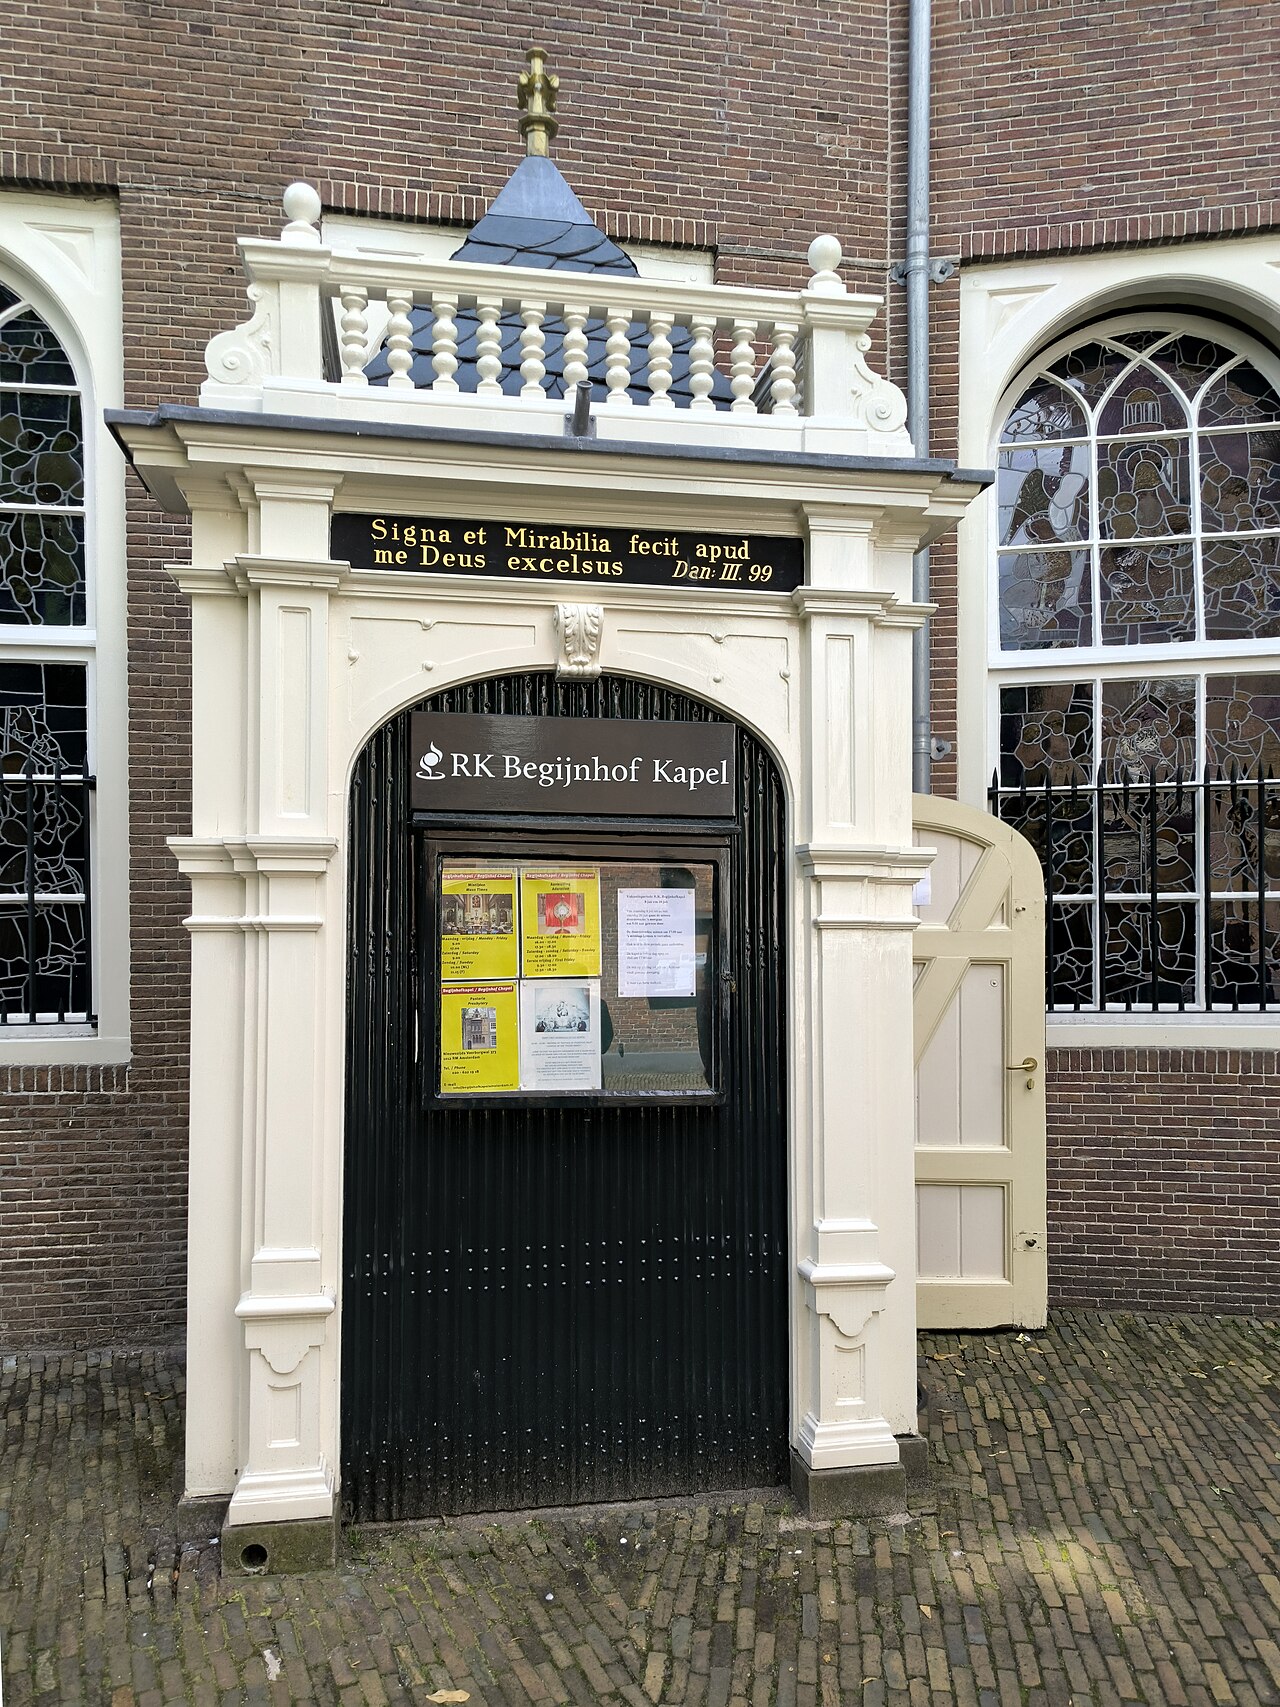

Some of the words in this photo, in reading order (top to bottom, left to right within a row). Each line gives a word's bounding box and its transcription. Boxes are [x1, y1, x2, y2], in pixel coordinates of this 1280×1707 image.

[371, 519, 452, 547] Signa
[464, 527, 487, 545] et
[504, 527, 612, 553] Mirabilia
[628, 534, 680, 556] fecit
[696, 540, 750, 563] apud
[374, 549, 408, 564] me
[420, 545, 486, 568] Deus
[508, 554, 624, 576] excelsus
[748, 564, 773, 582] 99
[450, 753, 496, 778] RK
[502, 756, 643, 788] Begijnhof
[652, 759, 730, 791] Kapel
